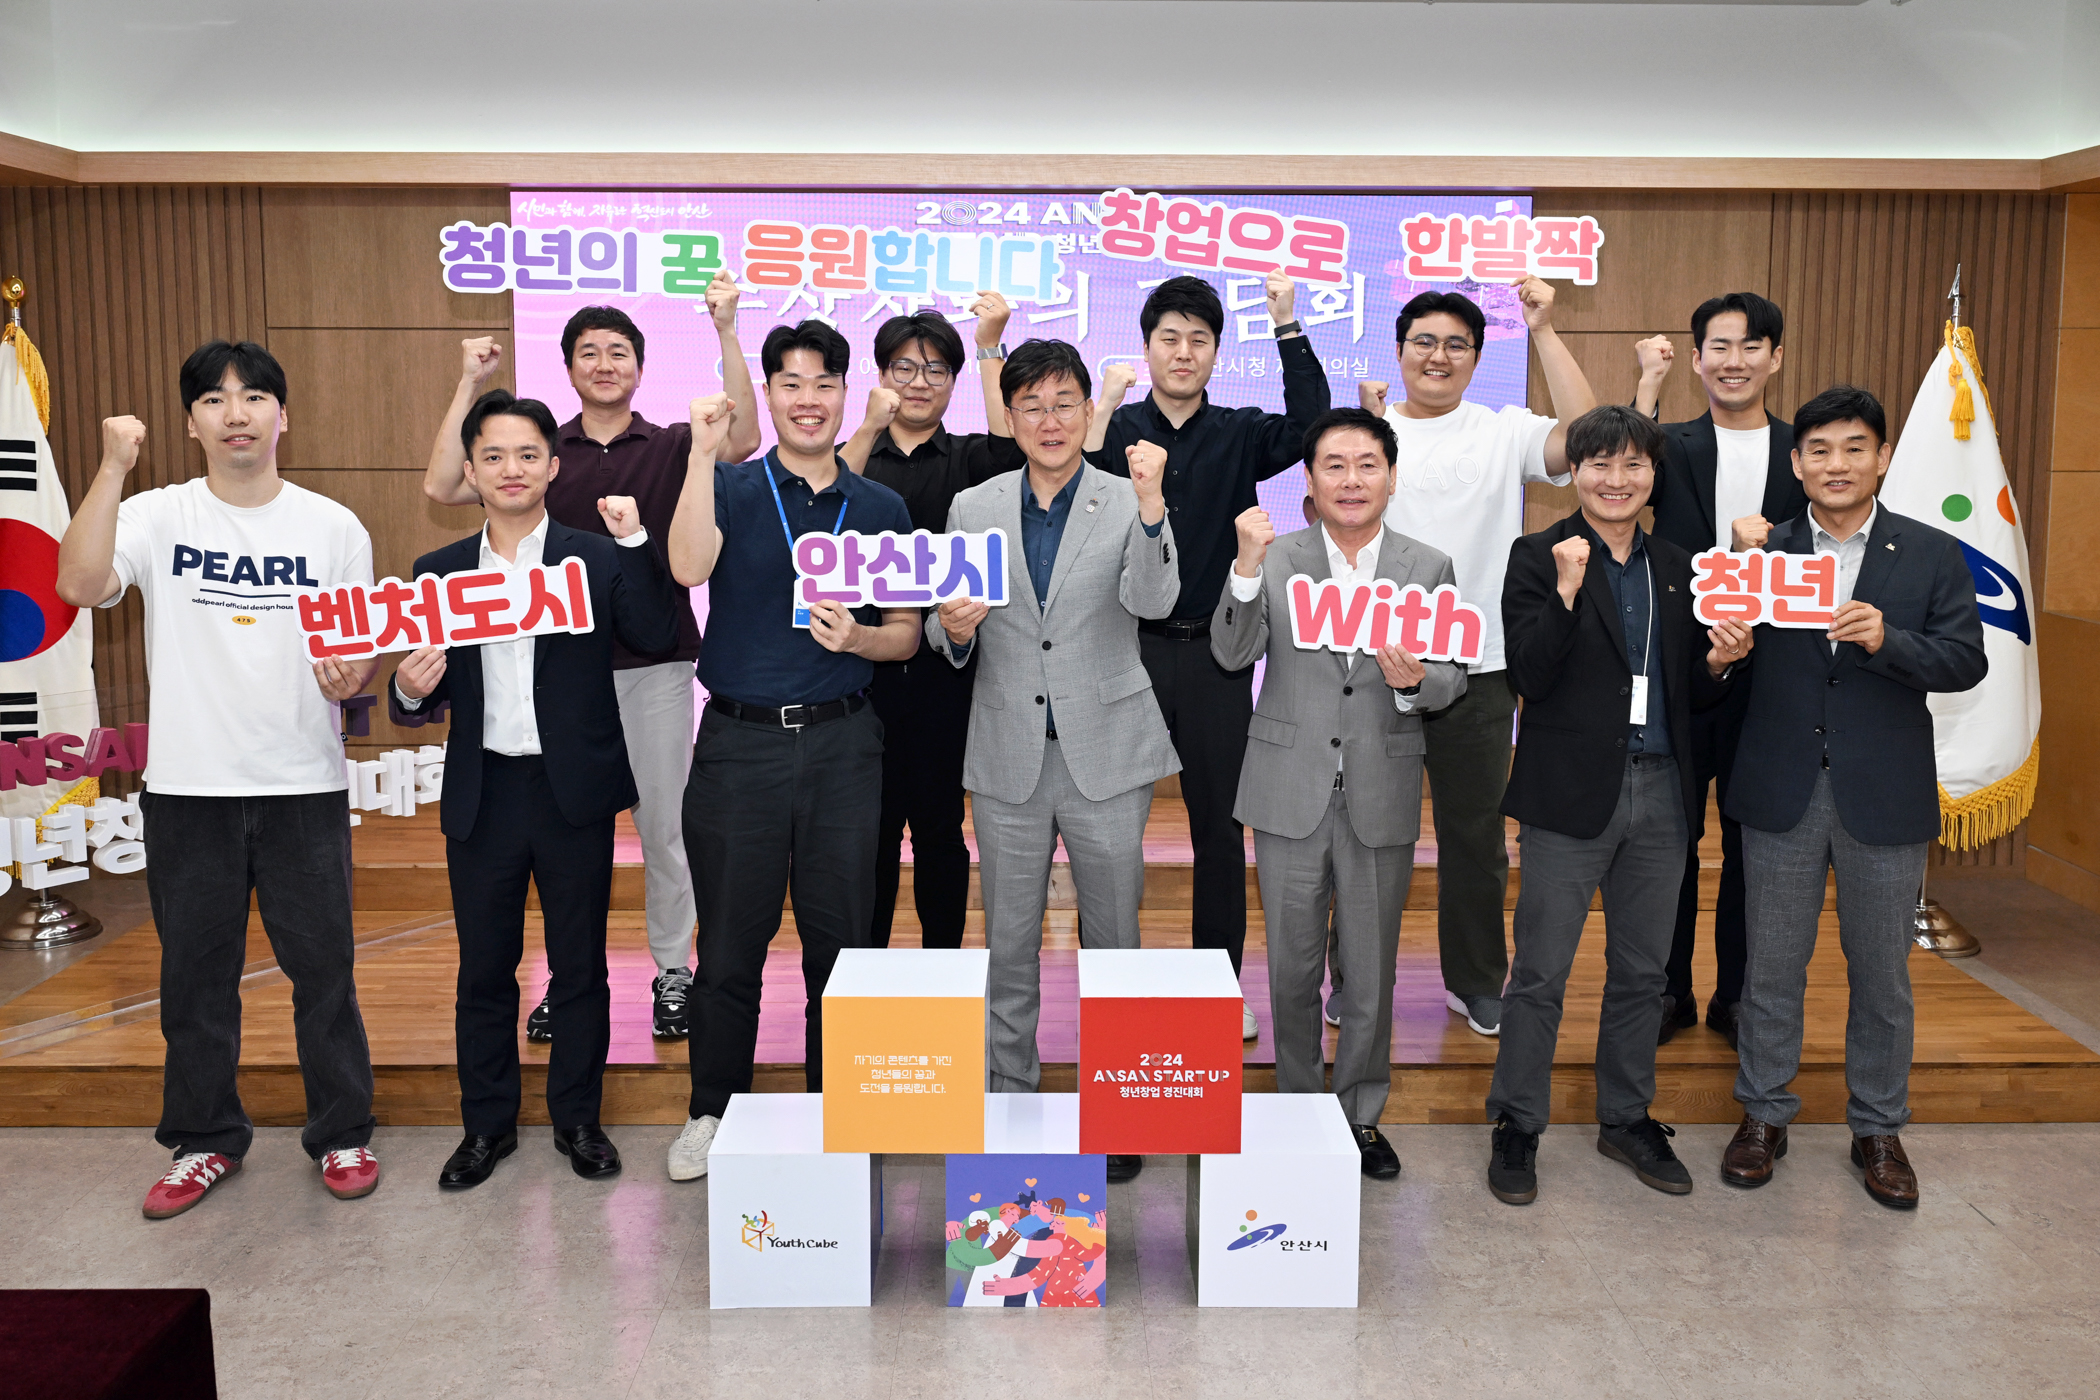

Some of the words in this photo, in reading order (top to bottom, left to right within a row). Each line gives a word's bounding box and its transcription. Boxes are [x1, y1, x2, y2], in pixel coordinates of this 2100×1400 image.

[678, 202, 713, 219] 안산
[915, 201, 1032, 226] 2024
[1057, 233, 1101, 255] 청년
[1100, 191, 1348, 284] 창업으로
[1404, 216, 1600, 280] 한발짝
[444, 225, 638, 293] 청년의
[660, 233, 723, 294] 꿈
[744, 224, 1061, 300] 응원합니다
[172, 544, 319, 588] PEARL
[797, 533, 1003, 603] 안산시
[1696, 551, 1836, 624] 청년
[191, 598, 225, 607] oddpearl
[226, 602, 249, 611] official
[250, 603, 275, 611] design
[297, 561, 589, 659] 벤처도시
[1292, 580, 1482, 658] With
[854, 1055, 885, 1066] 자기의
[931, 1055, 952, 1066] 가진
[1140, 1053, 1183, 1067] 2024
[871, 1069, 912, 1080] 청년들의
[914, 1069, 936, 1080] 꿈과
[1093, 1070, 1150, 1082] ANSAN
[1153, 1070, 1206, 1082] START
[1208, 1070, 1230, 1082] UP
[860, 1083, 891, 1094] 도전을
[892, 1083, 946, 1094] 응원합니다.
[1119, 1086, 1160, 1098] 청년창업
[1163, 1086, 1203, 1098] 경진대회
[1280, 1240, 1328, 1252] 안산시
